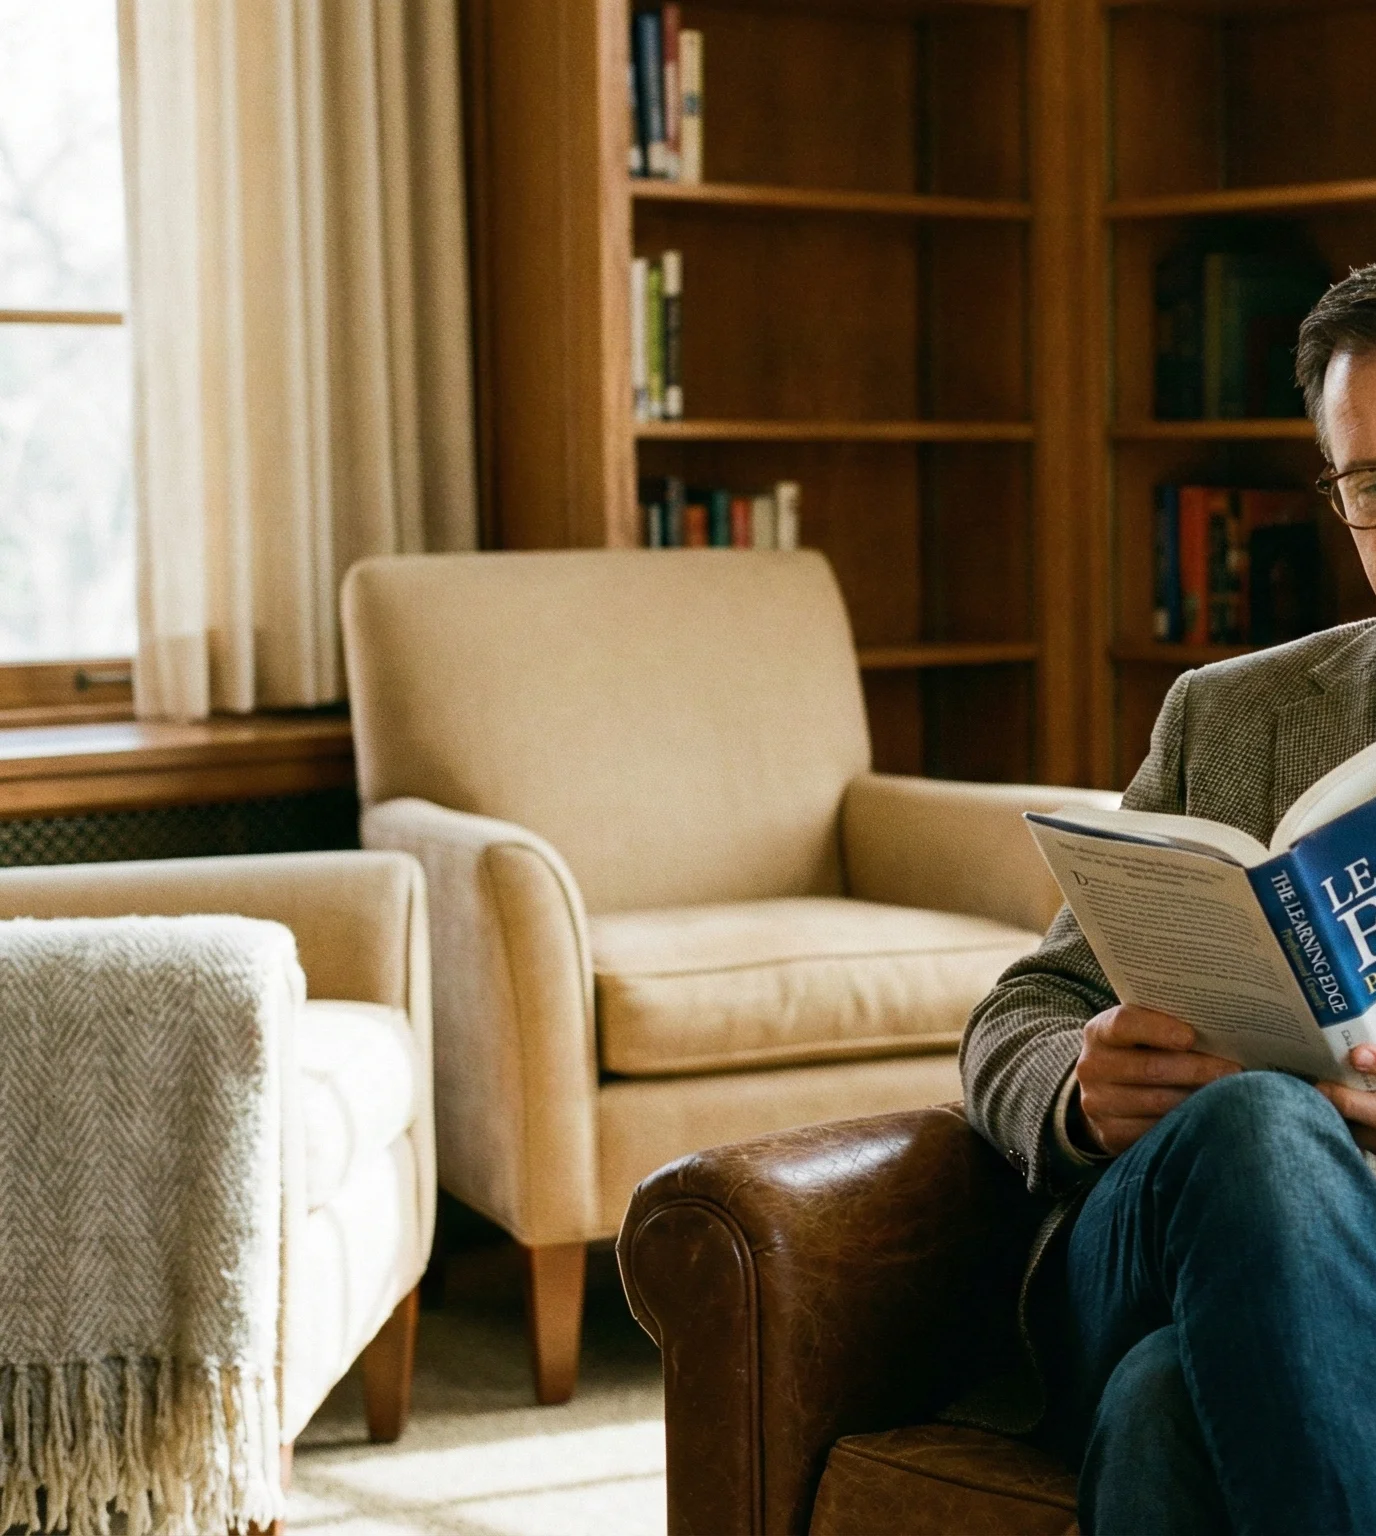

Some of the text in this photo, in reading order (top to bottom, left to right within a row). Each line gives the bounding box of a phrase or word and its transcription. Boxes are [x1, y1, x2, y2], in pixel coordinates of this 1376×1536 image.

[1271, 870, 1297, 902] THE
[1284, 900, 1331, 974] LEARNING
[1318, 974, 1348, 1014] EDGE
